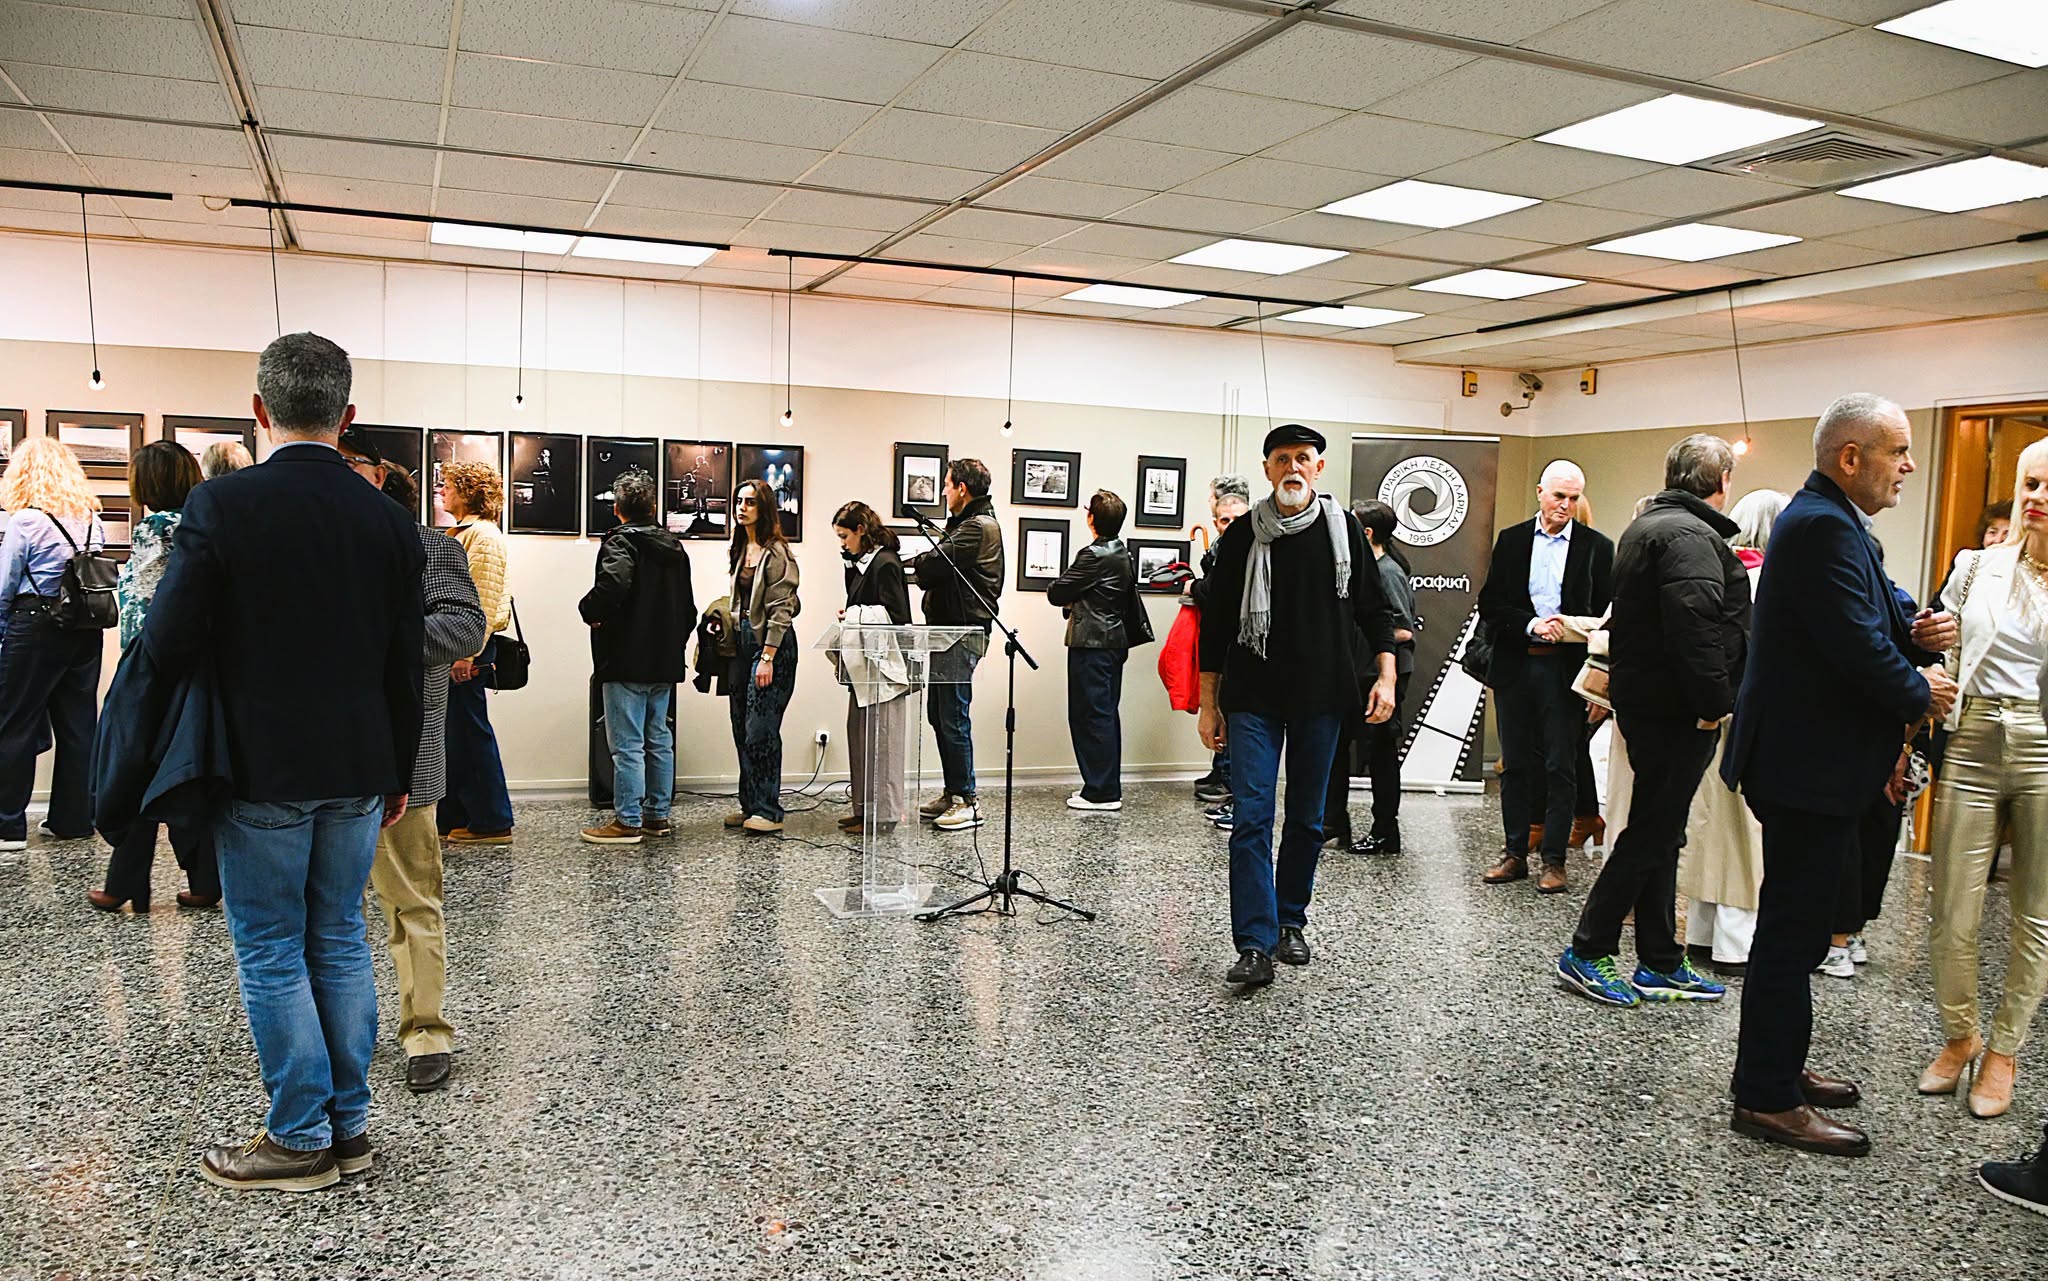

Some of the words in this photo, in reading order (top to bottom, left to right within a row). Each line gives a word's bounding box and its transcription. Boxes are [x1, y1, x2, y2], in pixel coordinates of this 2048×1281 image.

[1381, 460, 1418, 503] ΟΓΡΑΦΙΚΗ
[1422, 460, 1457, 482] ΛΕΣΧΗ
[1446, 484, 1465, 531] ΛΑΡΙΣΑΣ
[1408, 533, 1434, 544] 1996
[1409, 574, 1470, 593] ραφική
